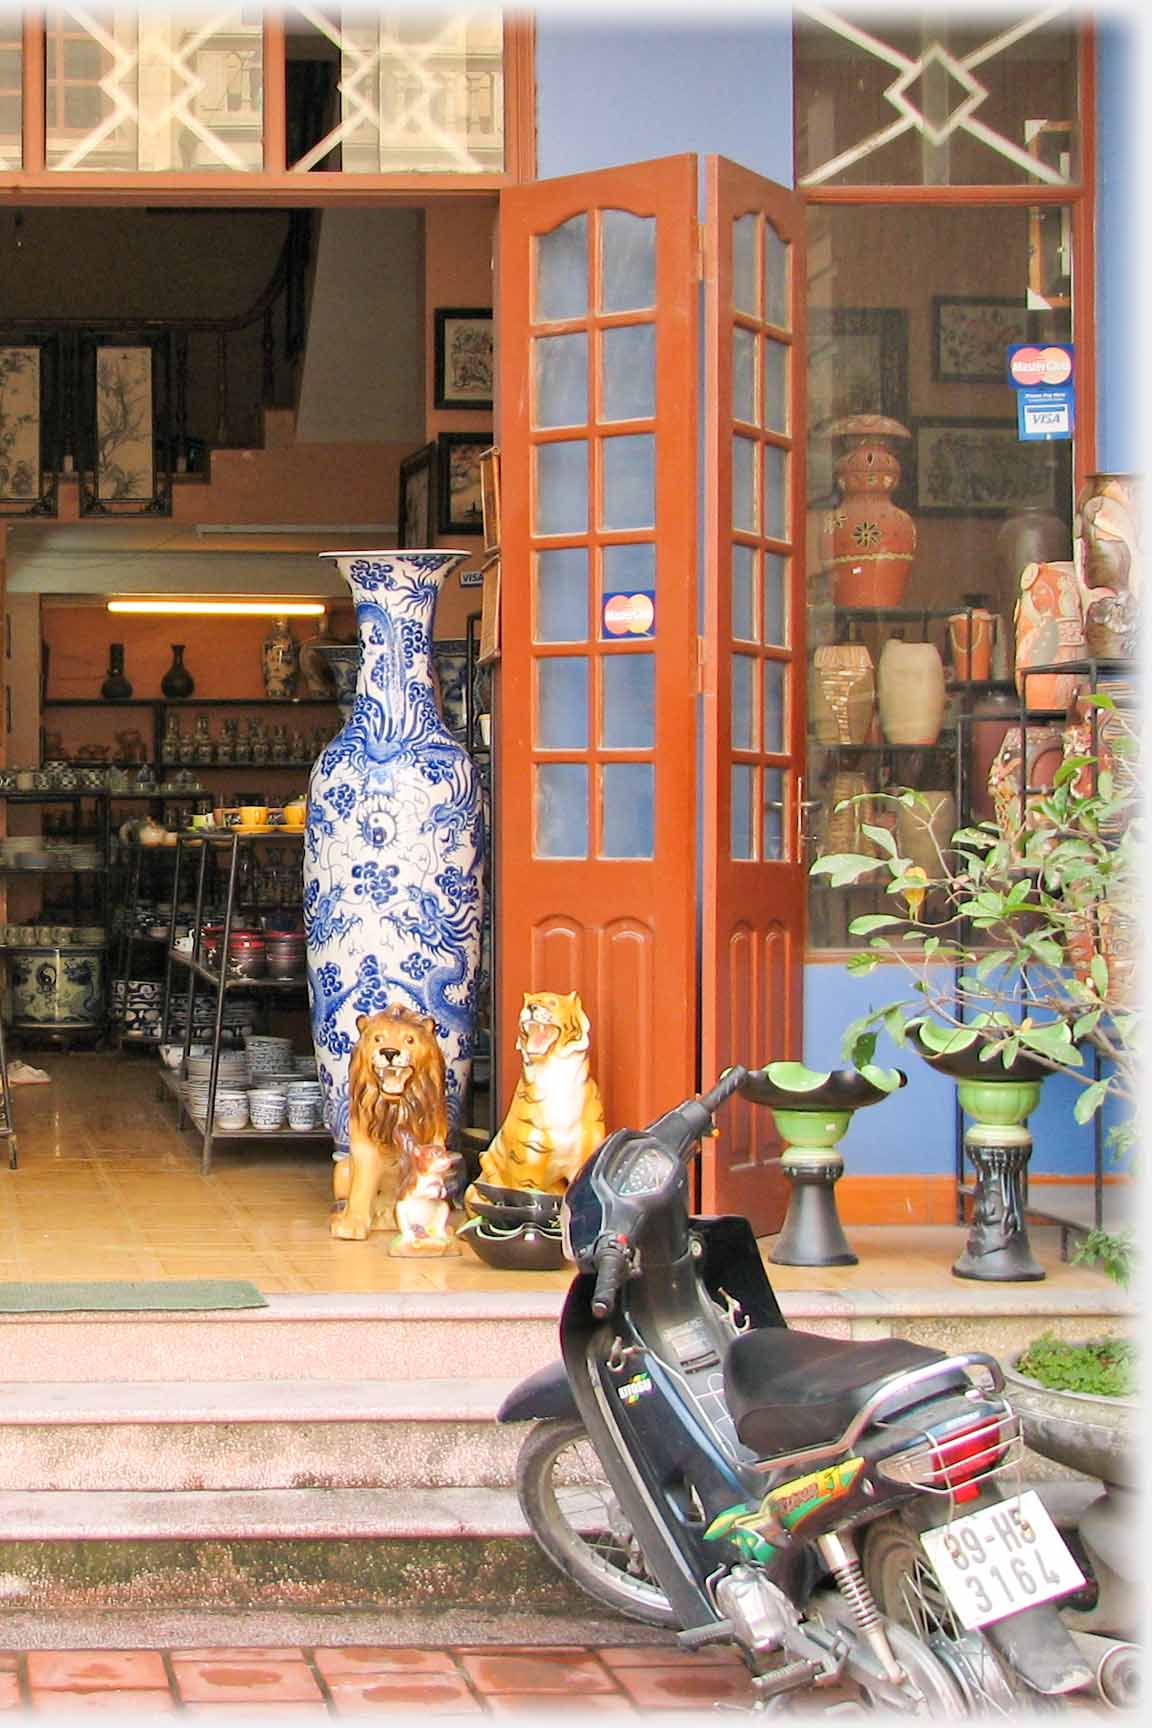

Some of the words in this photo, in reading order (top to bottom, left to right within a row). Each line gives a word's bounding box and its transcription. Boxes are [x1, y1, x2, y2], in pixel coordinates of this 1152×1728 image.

[1032, 413, 1061, 424] VISA
[943, 1508, 1037, 1571] 89-H5
[965, 1549, 1061, 1613] 3164
